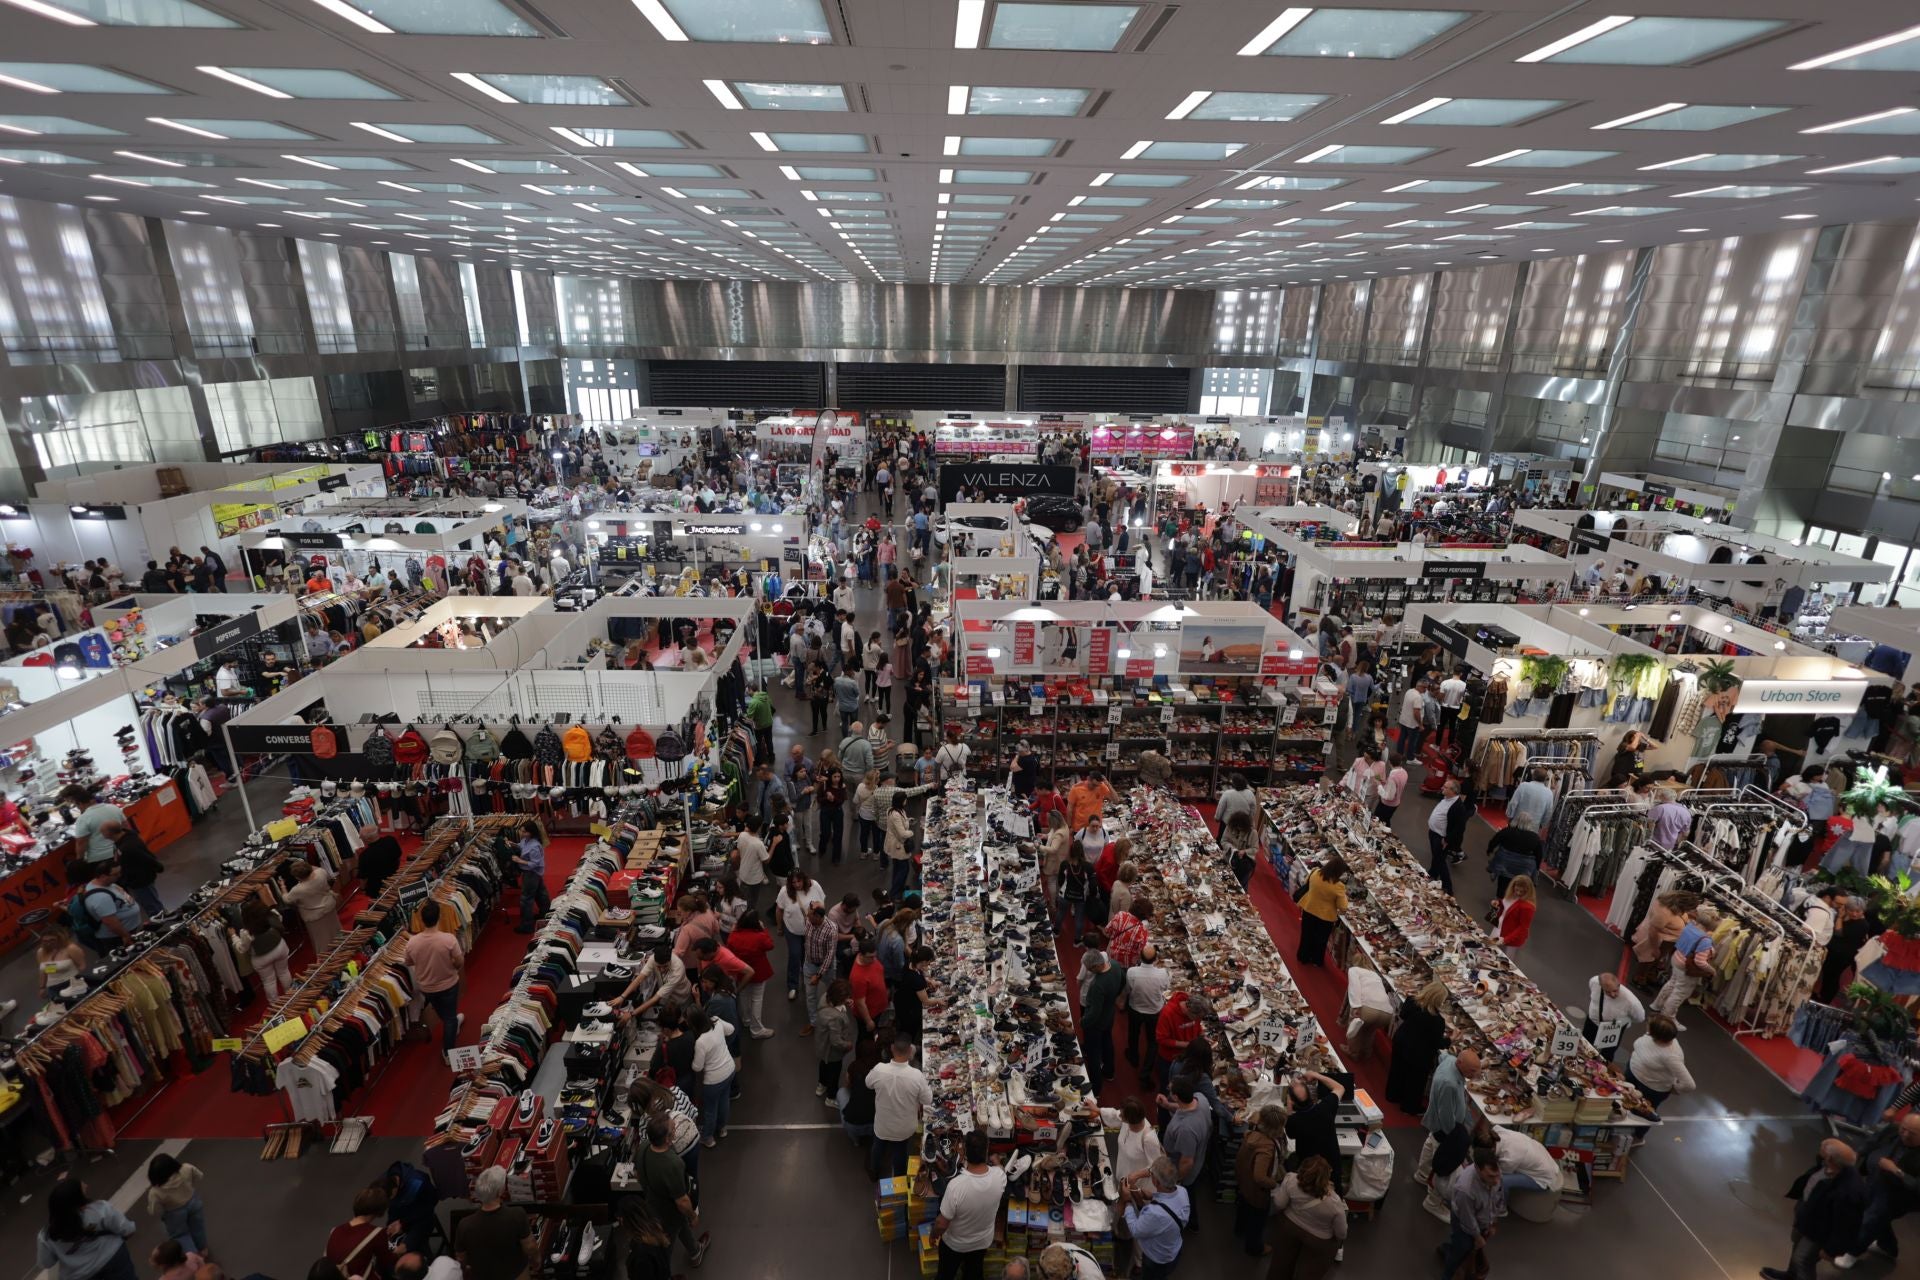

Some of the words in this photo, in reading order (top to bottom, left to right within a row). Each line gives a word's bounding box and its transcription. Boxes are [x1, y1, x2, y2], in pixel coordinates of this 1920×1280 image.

[770, 427, 783, 436] LA
[785, 427, 851, 437] OPORTDAD
[1181, 465, 1197, 476] Xti
[1264, 466, 1281, 477] Xti
[963, 473, 1051, 487] VALENZA
[784, 549, 799, 559] EA7
[1760, 689, 1803, 702] Urban
[1806, 689, 1841, 702] Store
[265, 735, 311, 744] CONVERSE
[1262, 1031, 1280, 1042] 37
[1301, 1032, 1313, 1046] 38
[1601, 1034, 1617, 1044] 40
[1557, 1041, 1575, 1052] 39
[1028, 1051, 1039, 1064] 41
